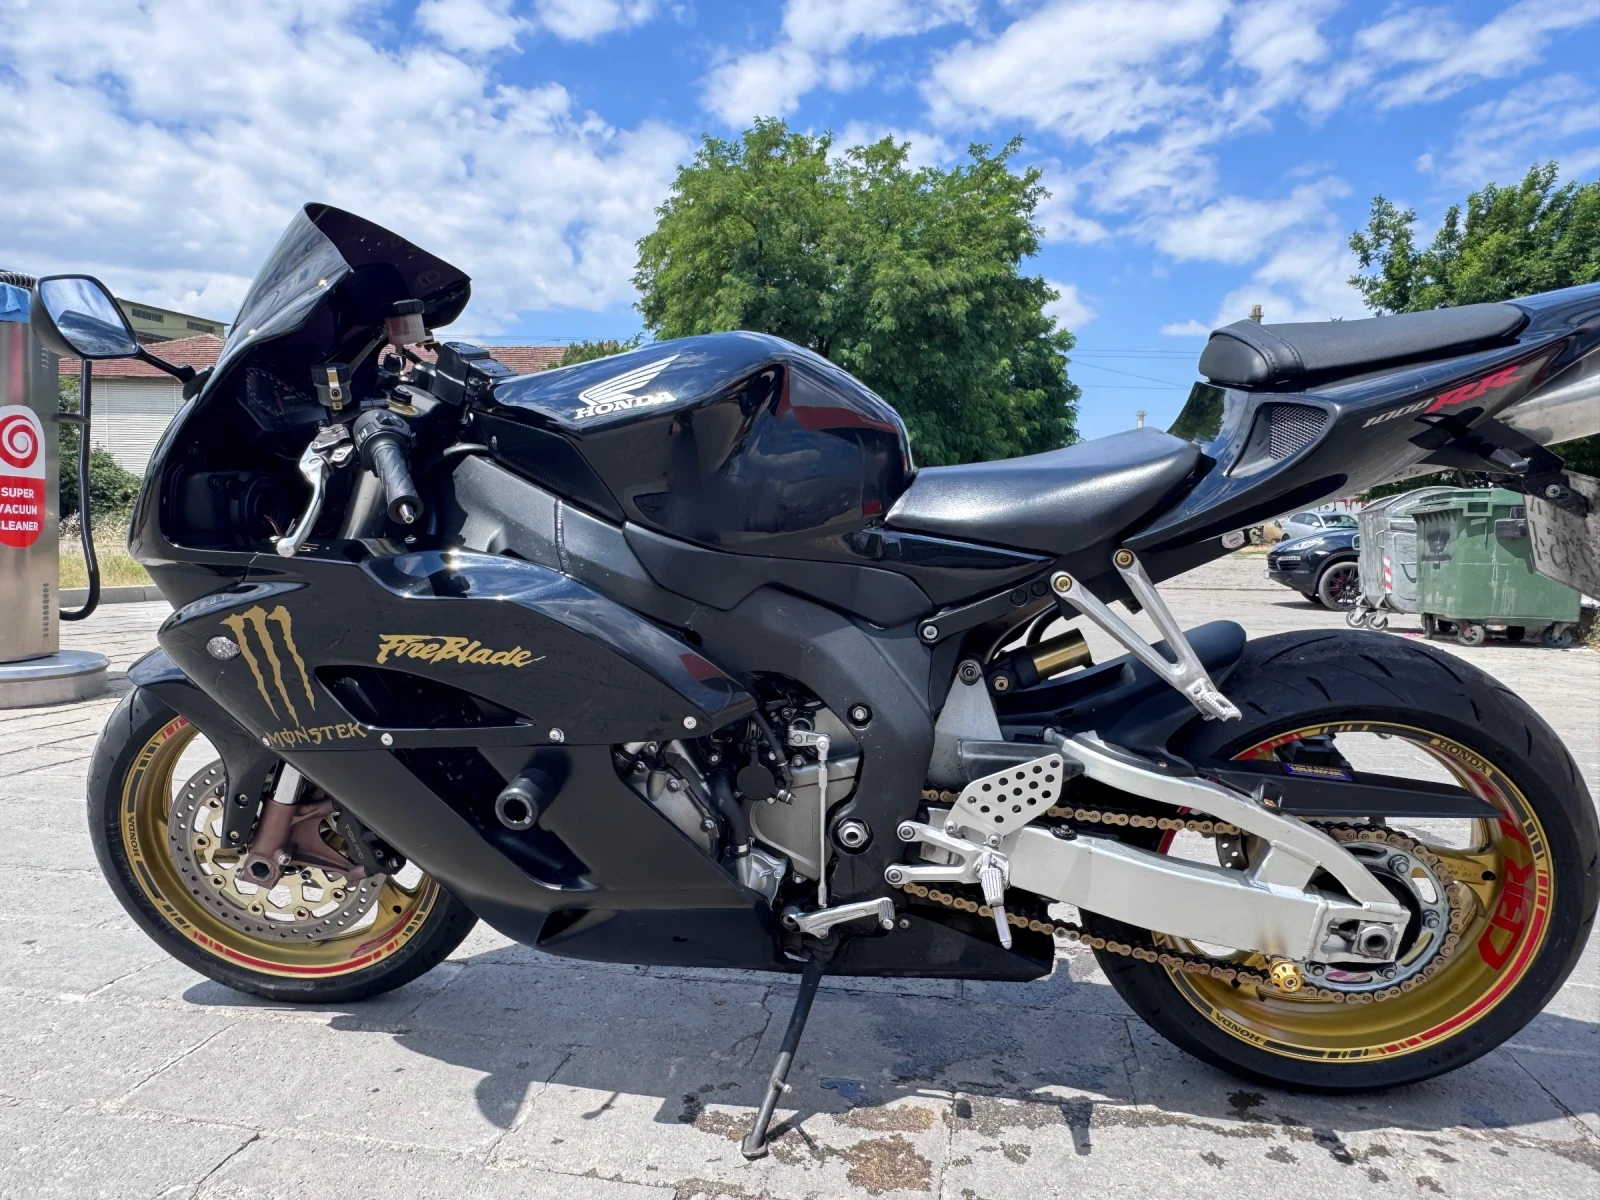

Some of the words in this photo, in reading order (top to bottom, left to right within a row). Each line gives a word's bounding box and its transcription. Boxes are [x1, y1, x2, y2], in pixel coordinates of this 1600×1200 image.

[574, 391, 677, 420] HONDA
[1, 487, 35, 499] SUPER
[0, 520, 39, 531] LEANER
[376, 634, 546, 668] FireBlade
[1440, 741, 1488, 774] HONDA
[127, 815, 140, 857] HONDA
[345, 823, 365, 859] TOKICO
[1215, 1011, 1261, 1042] HONDA
